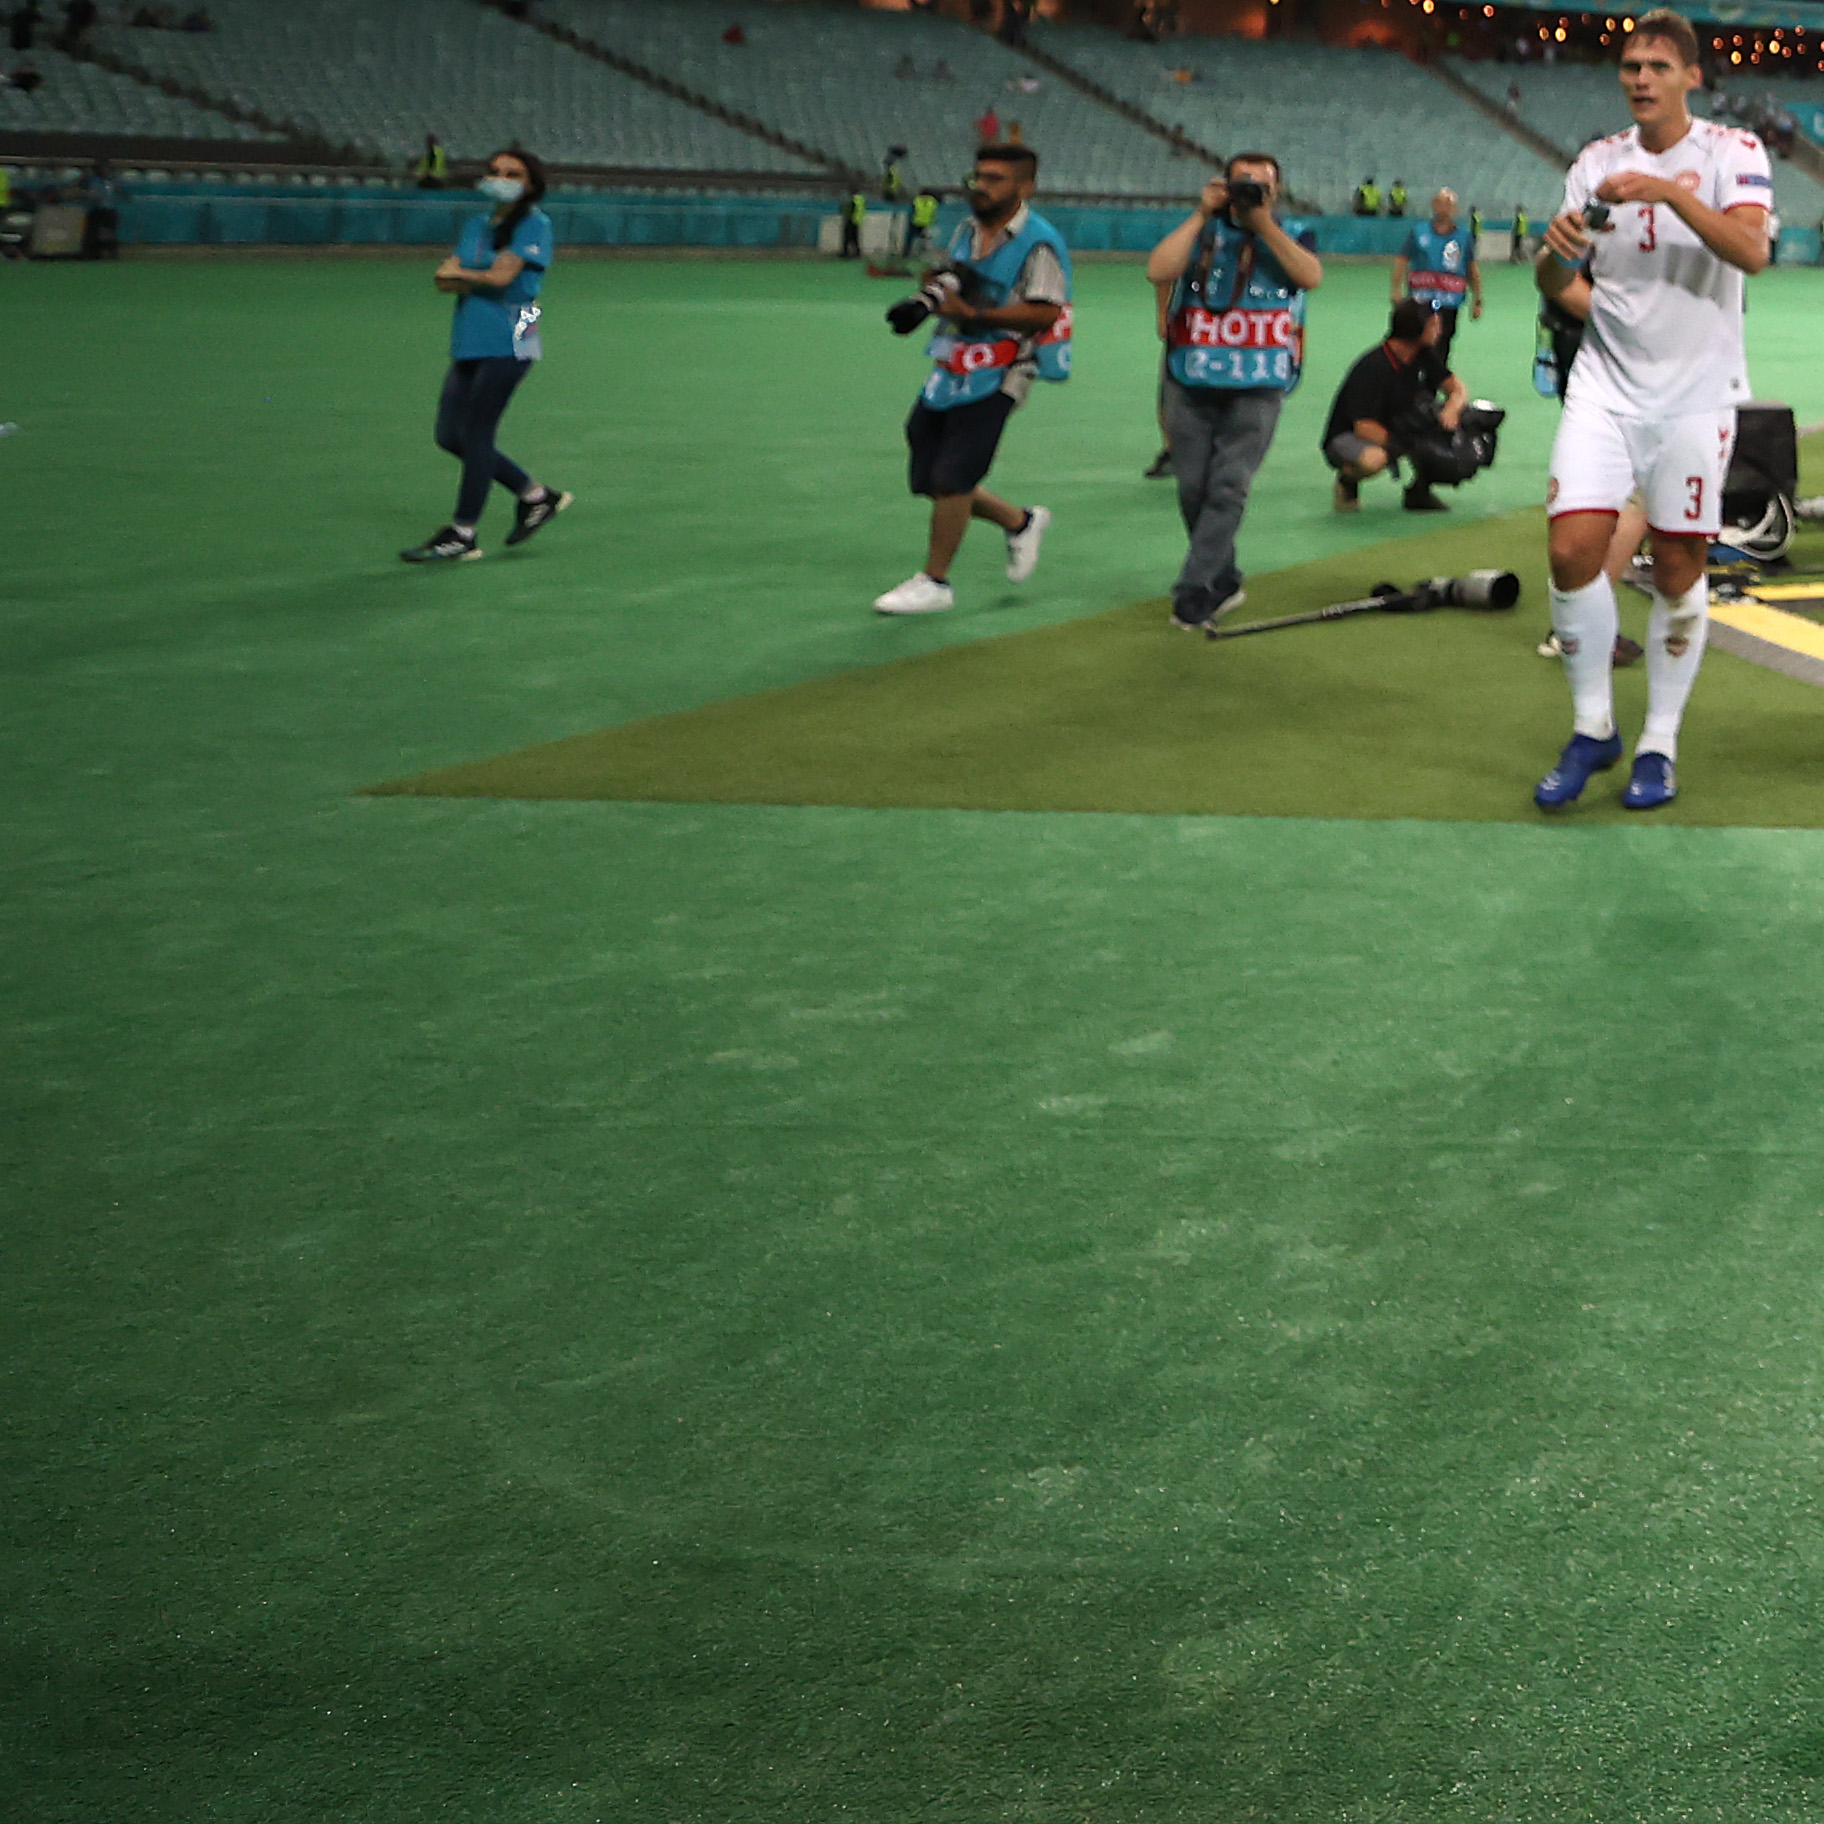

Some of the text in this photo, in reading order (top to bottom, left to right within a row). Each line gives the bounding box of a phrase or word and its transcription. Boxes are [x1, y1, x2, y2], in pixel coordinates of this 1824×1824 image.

[1639, 205, 1655, 253] 3
[1185, 310, 1291, 346] HOTO
[1684, 476, 1704, 520] 3
